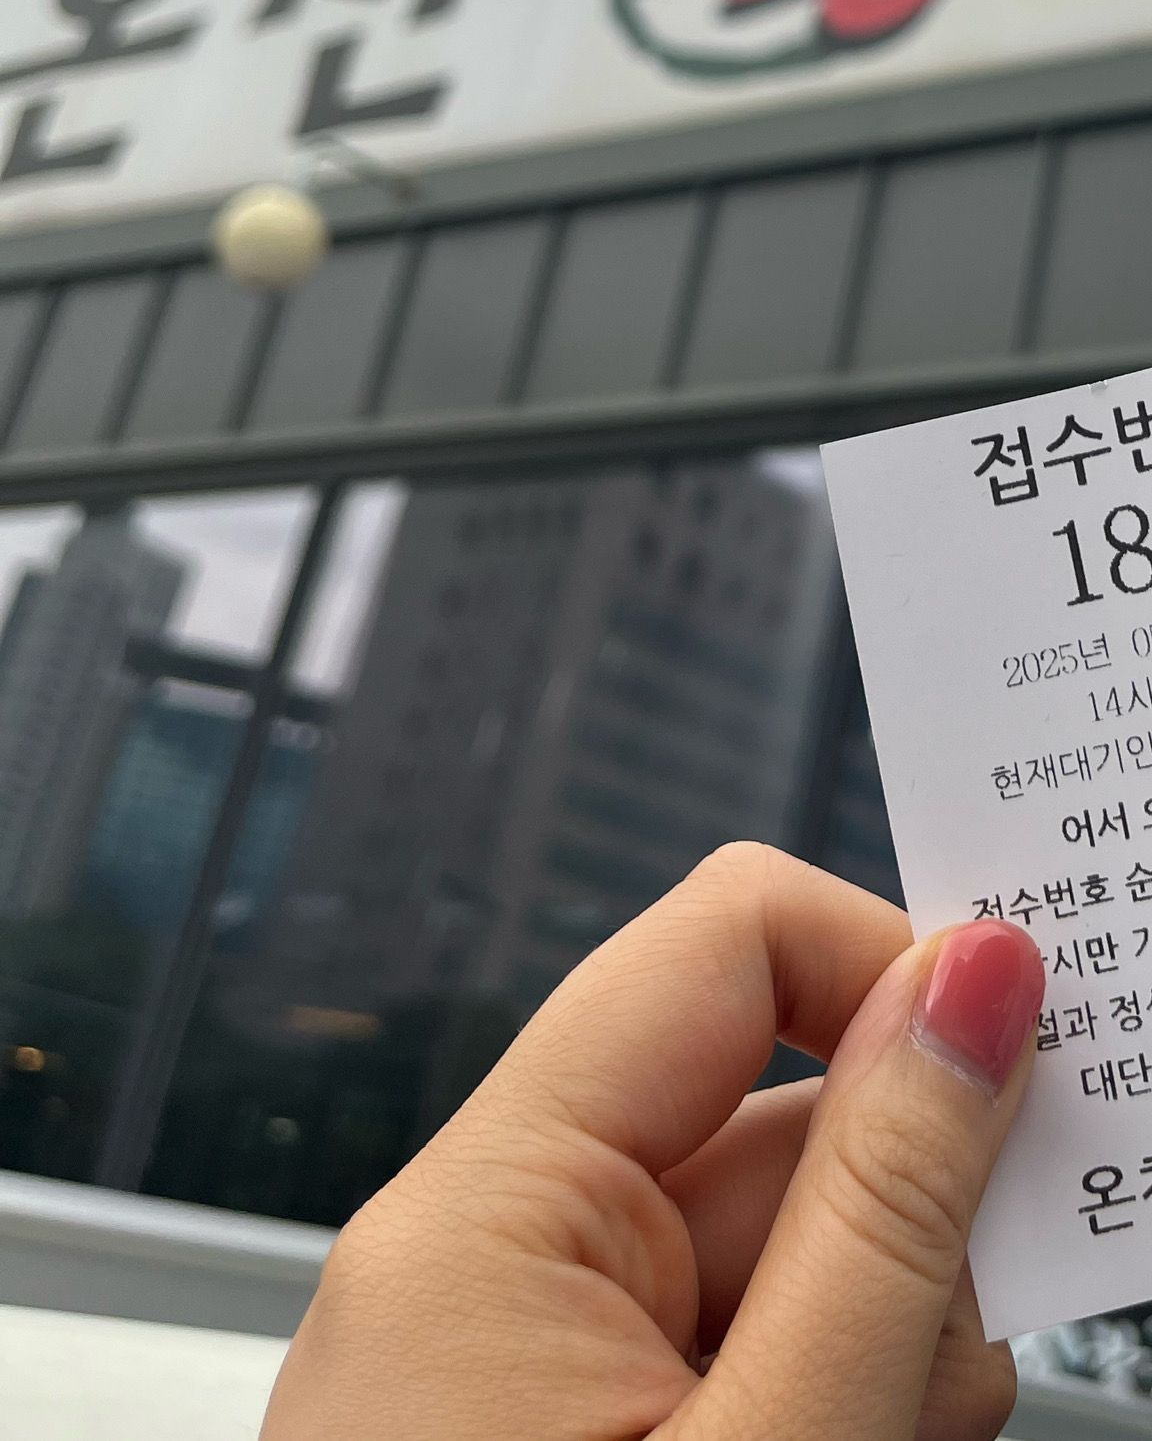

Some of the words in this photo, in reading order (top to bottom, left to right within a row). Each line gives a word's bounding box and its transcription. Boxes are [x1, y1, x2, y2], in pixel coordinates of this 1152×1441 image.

[1002, 632, 1112, 688] 2025년
[1061, 801, 1131, 848] 어서
[1039, 932, 1119, 978] 시만
